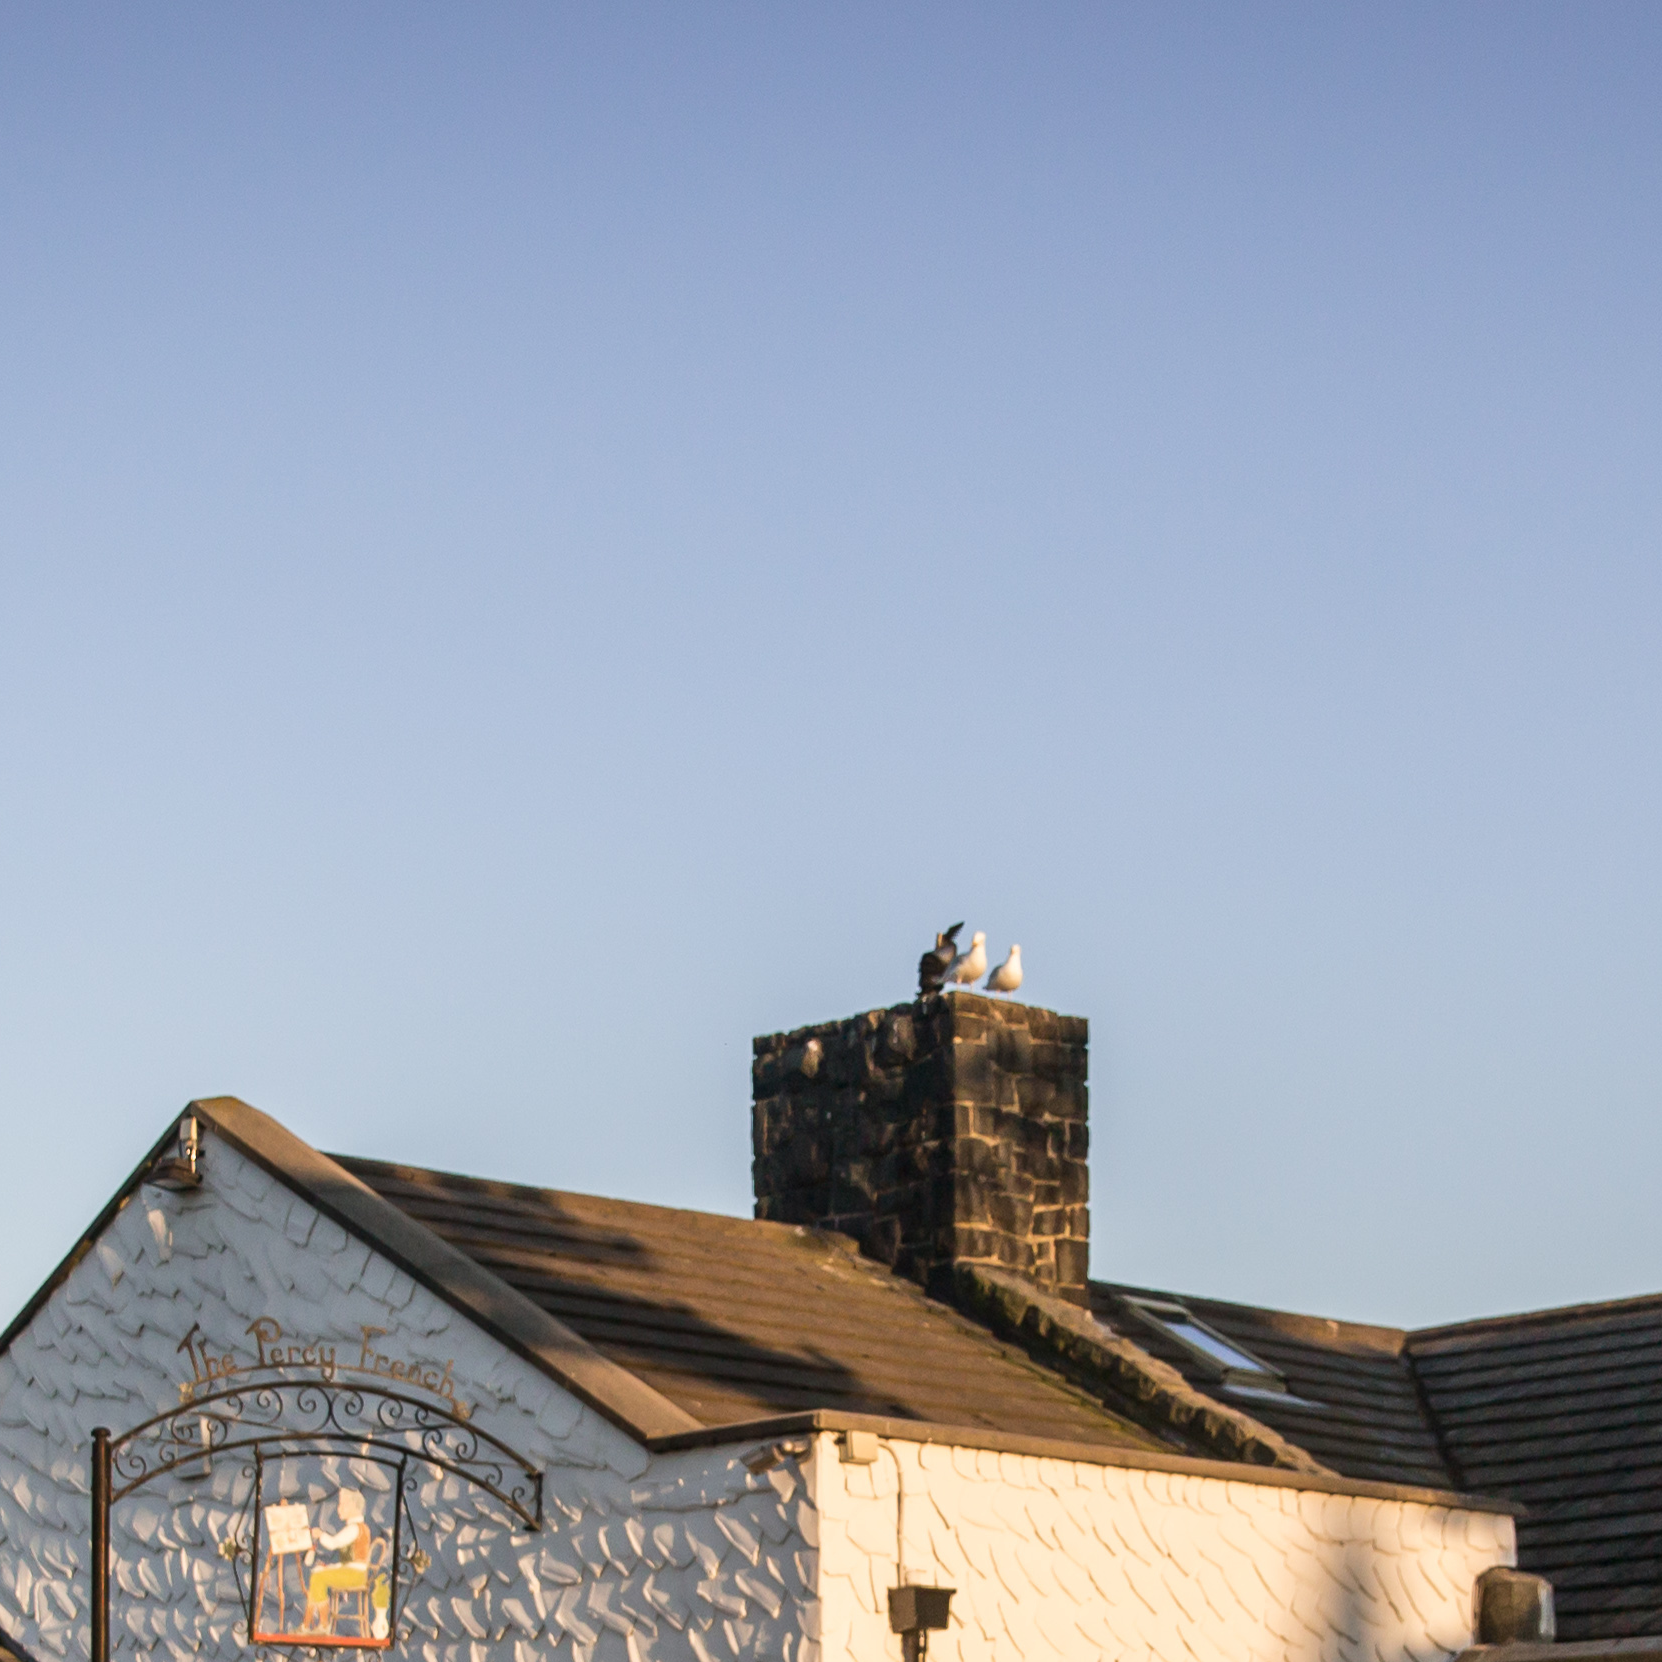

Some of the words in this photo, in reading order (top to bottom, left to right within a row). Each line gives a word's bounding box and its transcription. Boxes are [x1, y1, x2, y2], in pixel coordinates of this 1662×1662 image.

[177, 1322, 238, 1382] The
[245, 1316, 336, 1382] Percy
[360, 1324, 456, 1400] French
